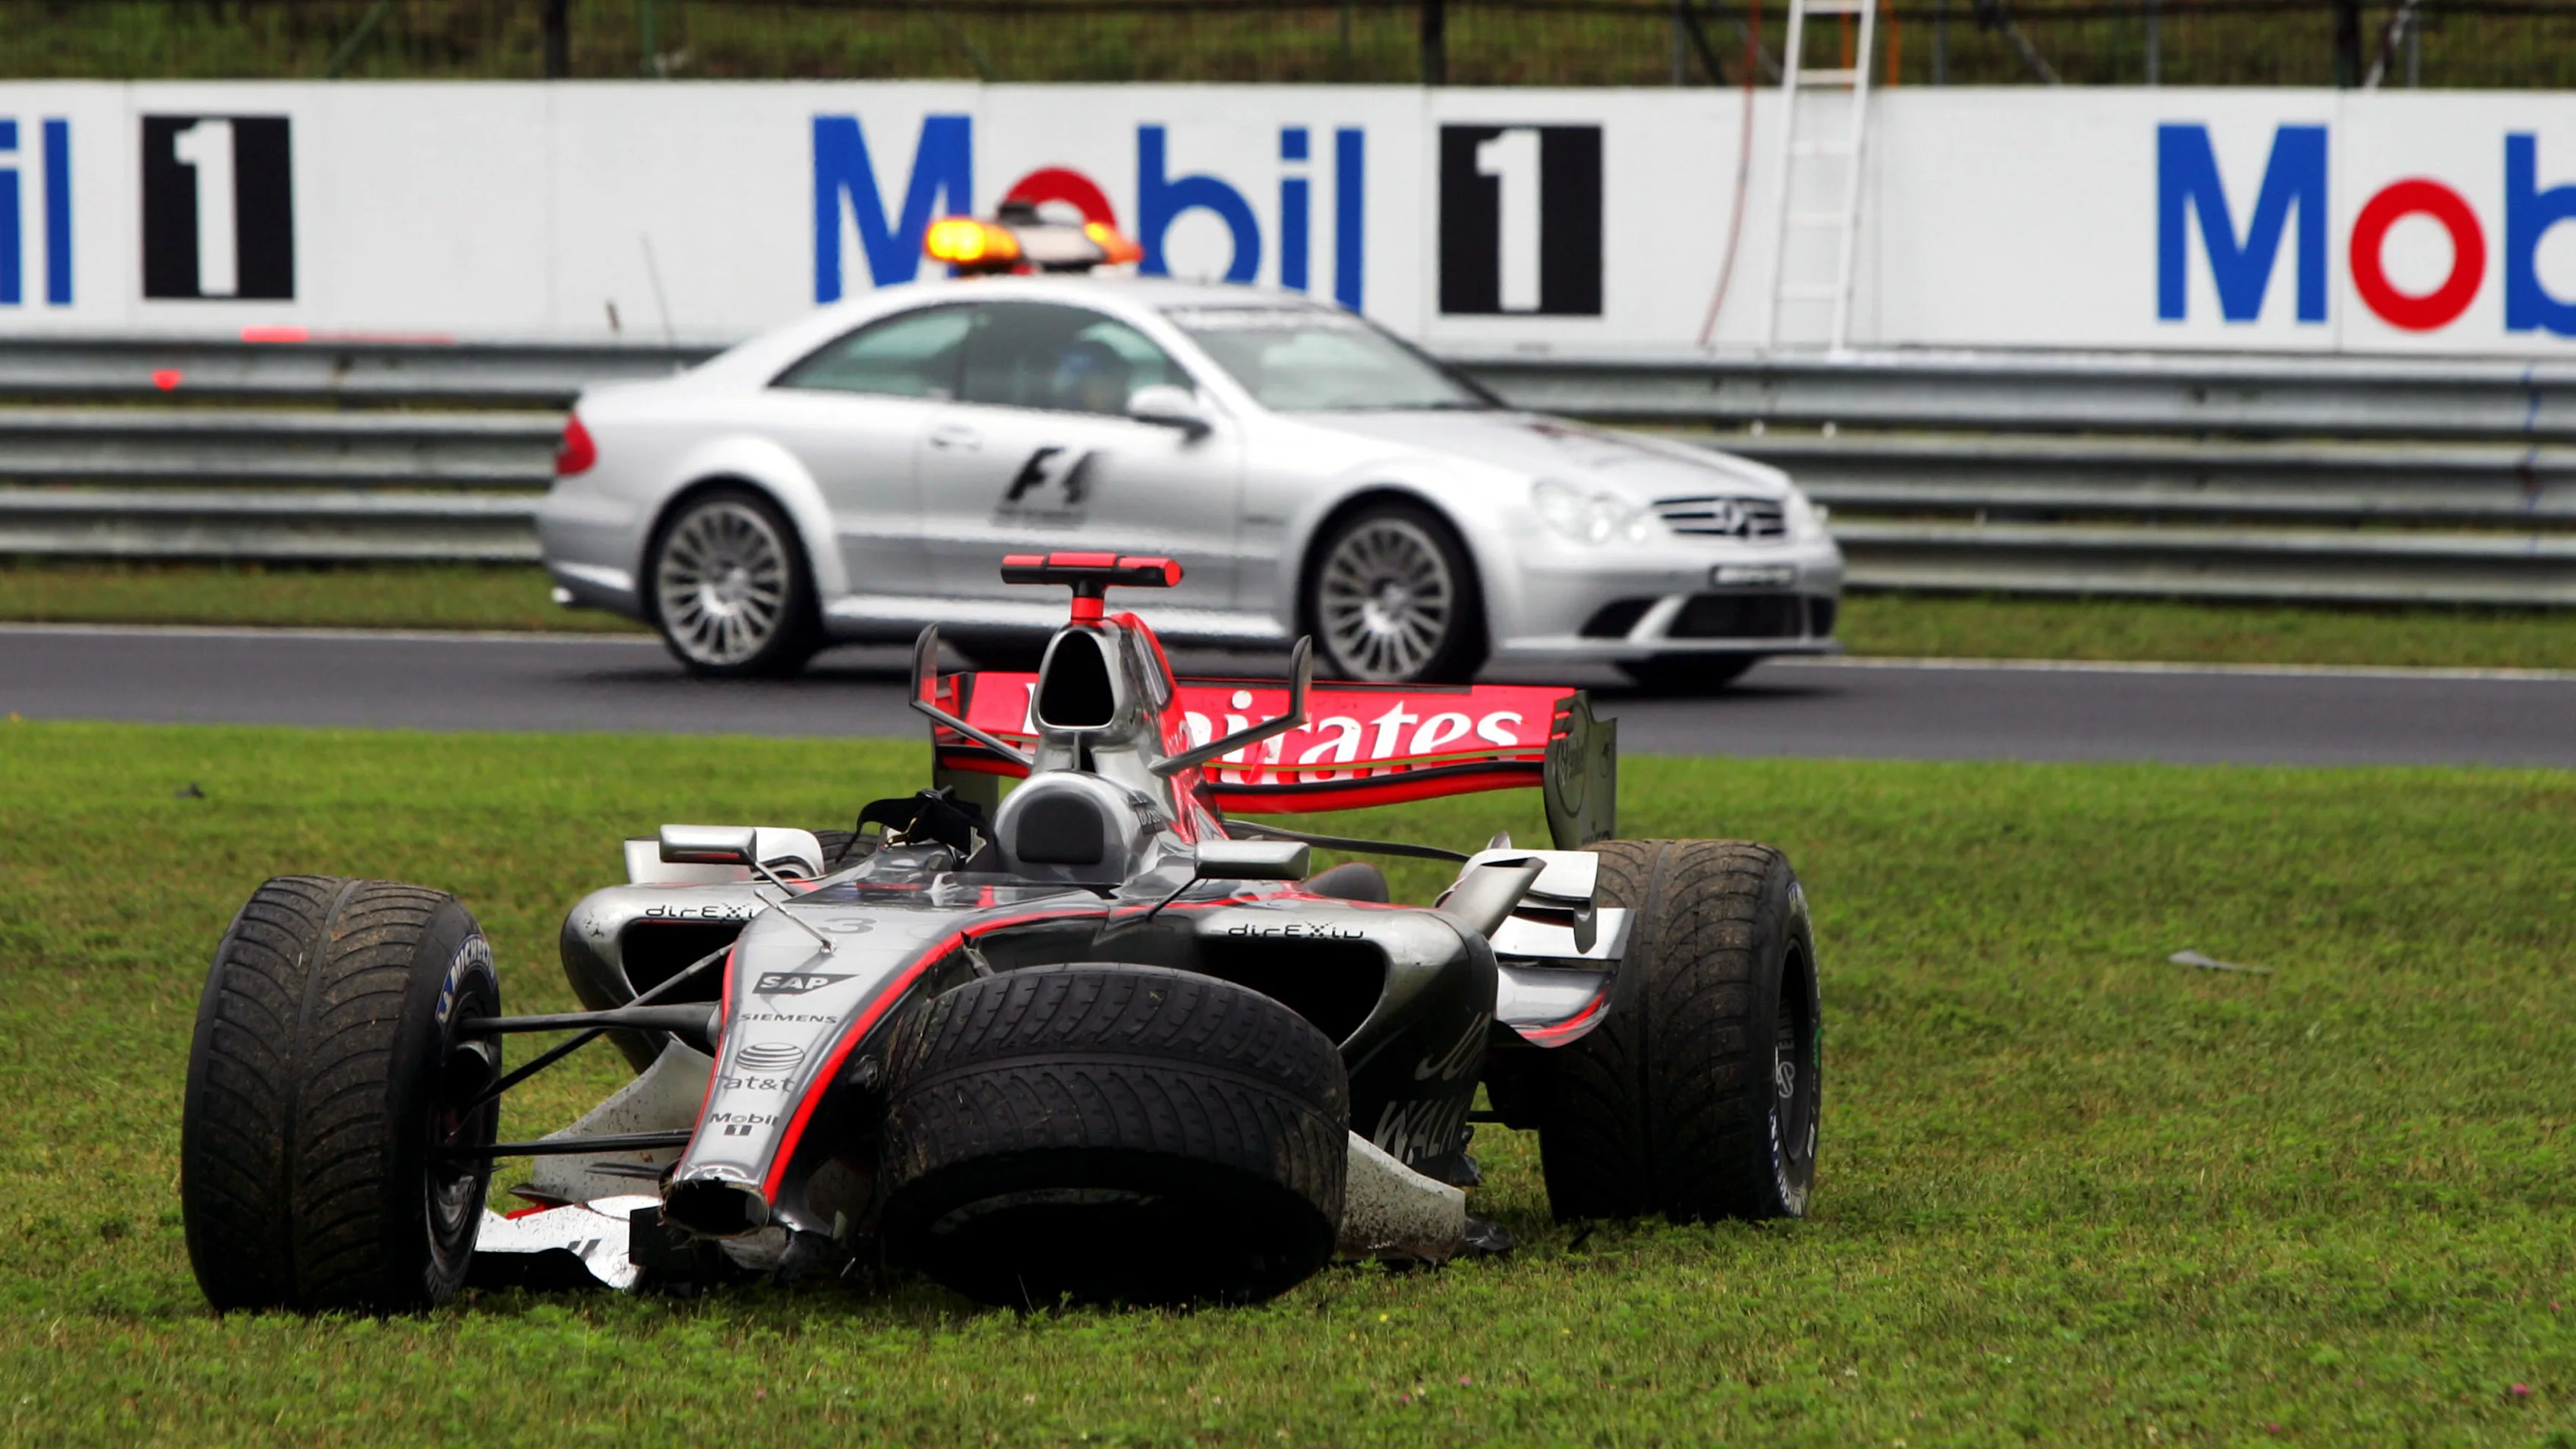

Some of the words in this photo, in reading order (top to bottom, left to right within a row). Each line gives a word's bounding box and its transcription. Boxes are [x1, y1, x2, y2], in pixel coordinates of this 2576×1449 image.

[173, 119, 237, 296] 1
[1477, 129, 1542, 311] 1
[816, 917, 878, 934] 3
[759, 976, 830, 990] SAP
[738, 1013, 838, 1024] SIEMENS
[723, 1075, 796, 1093] at&t
[709, 1113, 778, 1125] Mobil
